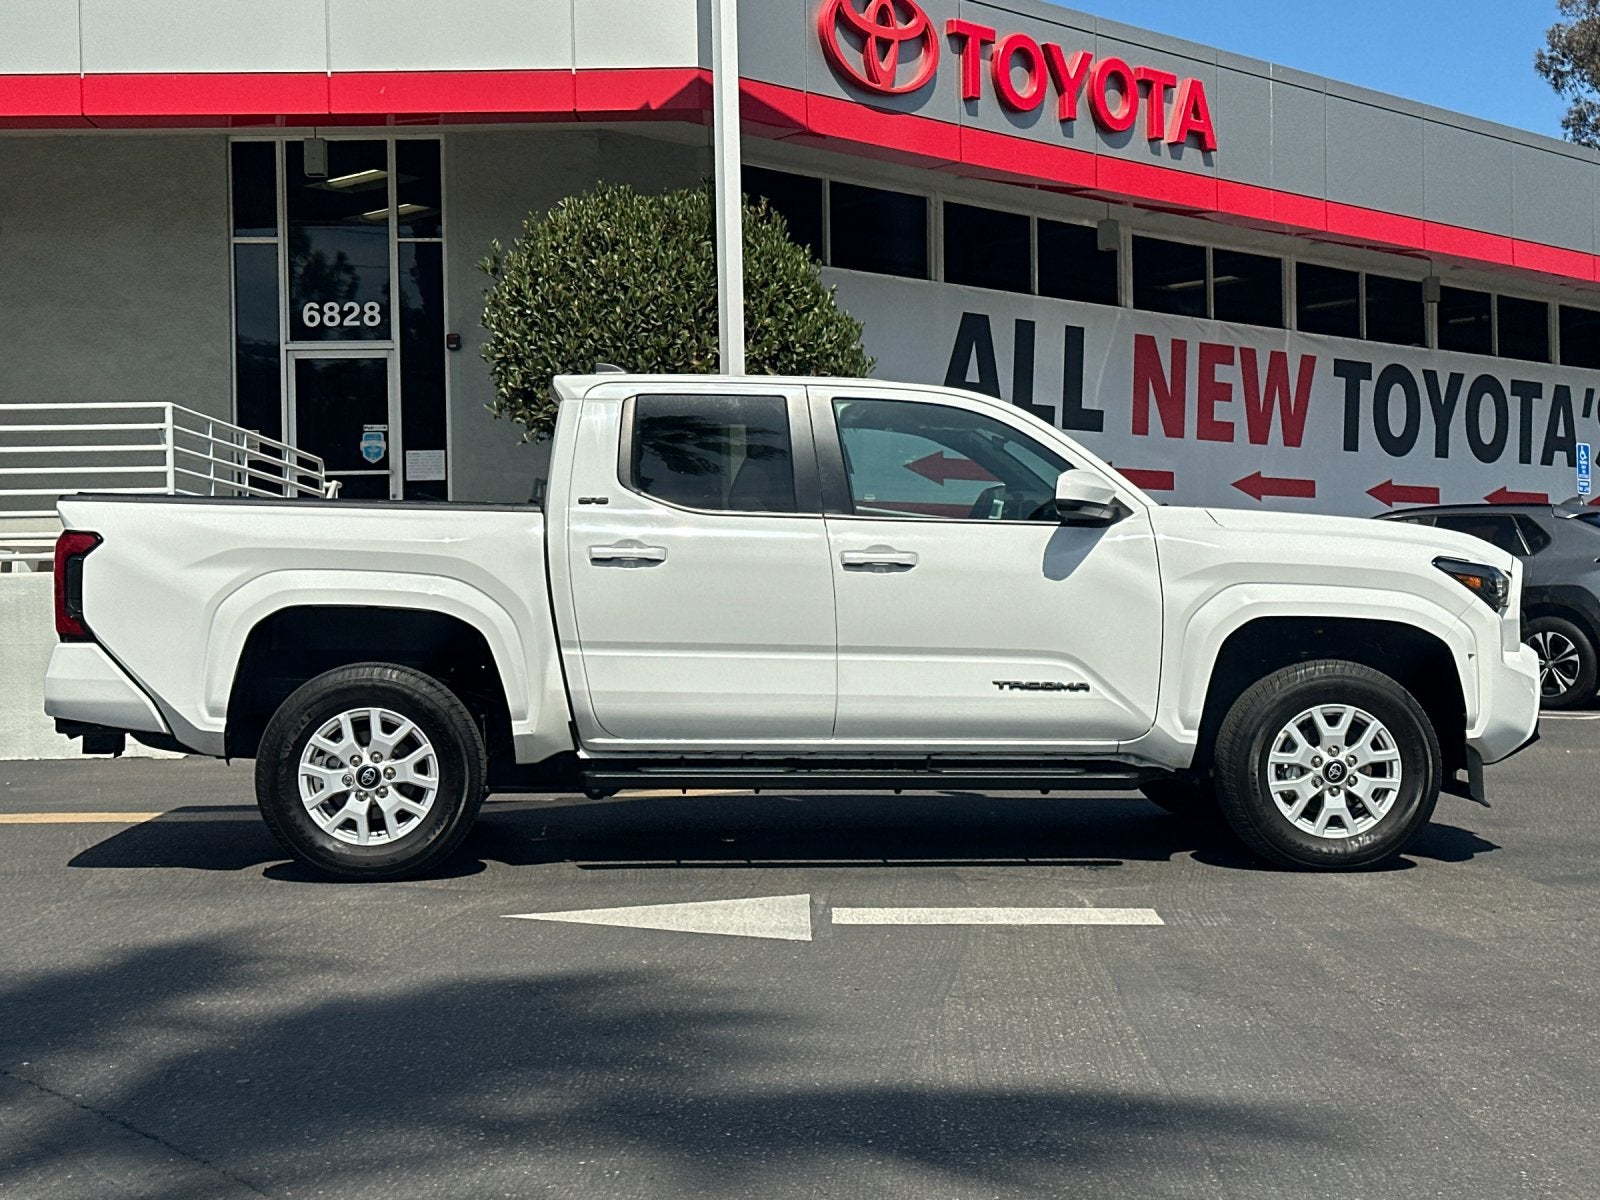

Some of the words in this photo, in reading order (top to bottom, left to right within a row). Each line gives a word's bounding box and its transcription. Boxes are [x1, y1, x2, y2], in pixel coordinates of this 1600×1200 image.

[946, 17, 1218, 152] TOYOTA
[302, 301, 382, 327] 6828
[943, 311, 1105, 433] ALL
[1131, 334, 1317, 448] NEW
[1332, 358, 1600, 468] TOYOTA'
[992, 680, 1091, 692] TACOMA
